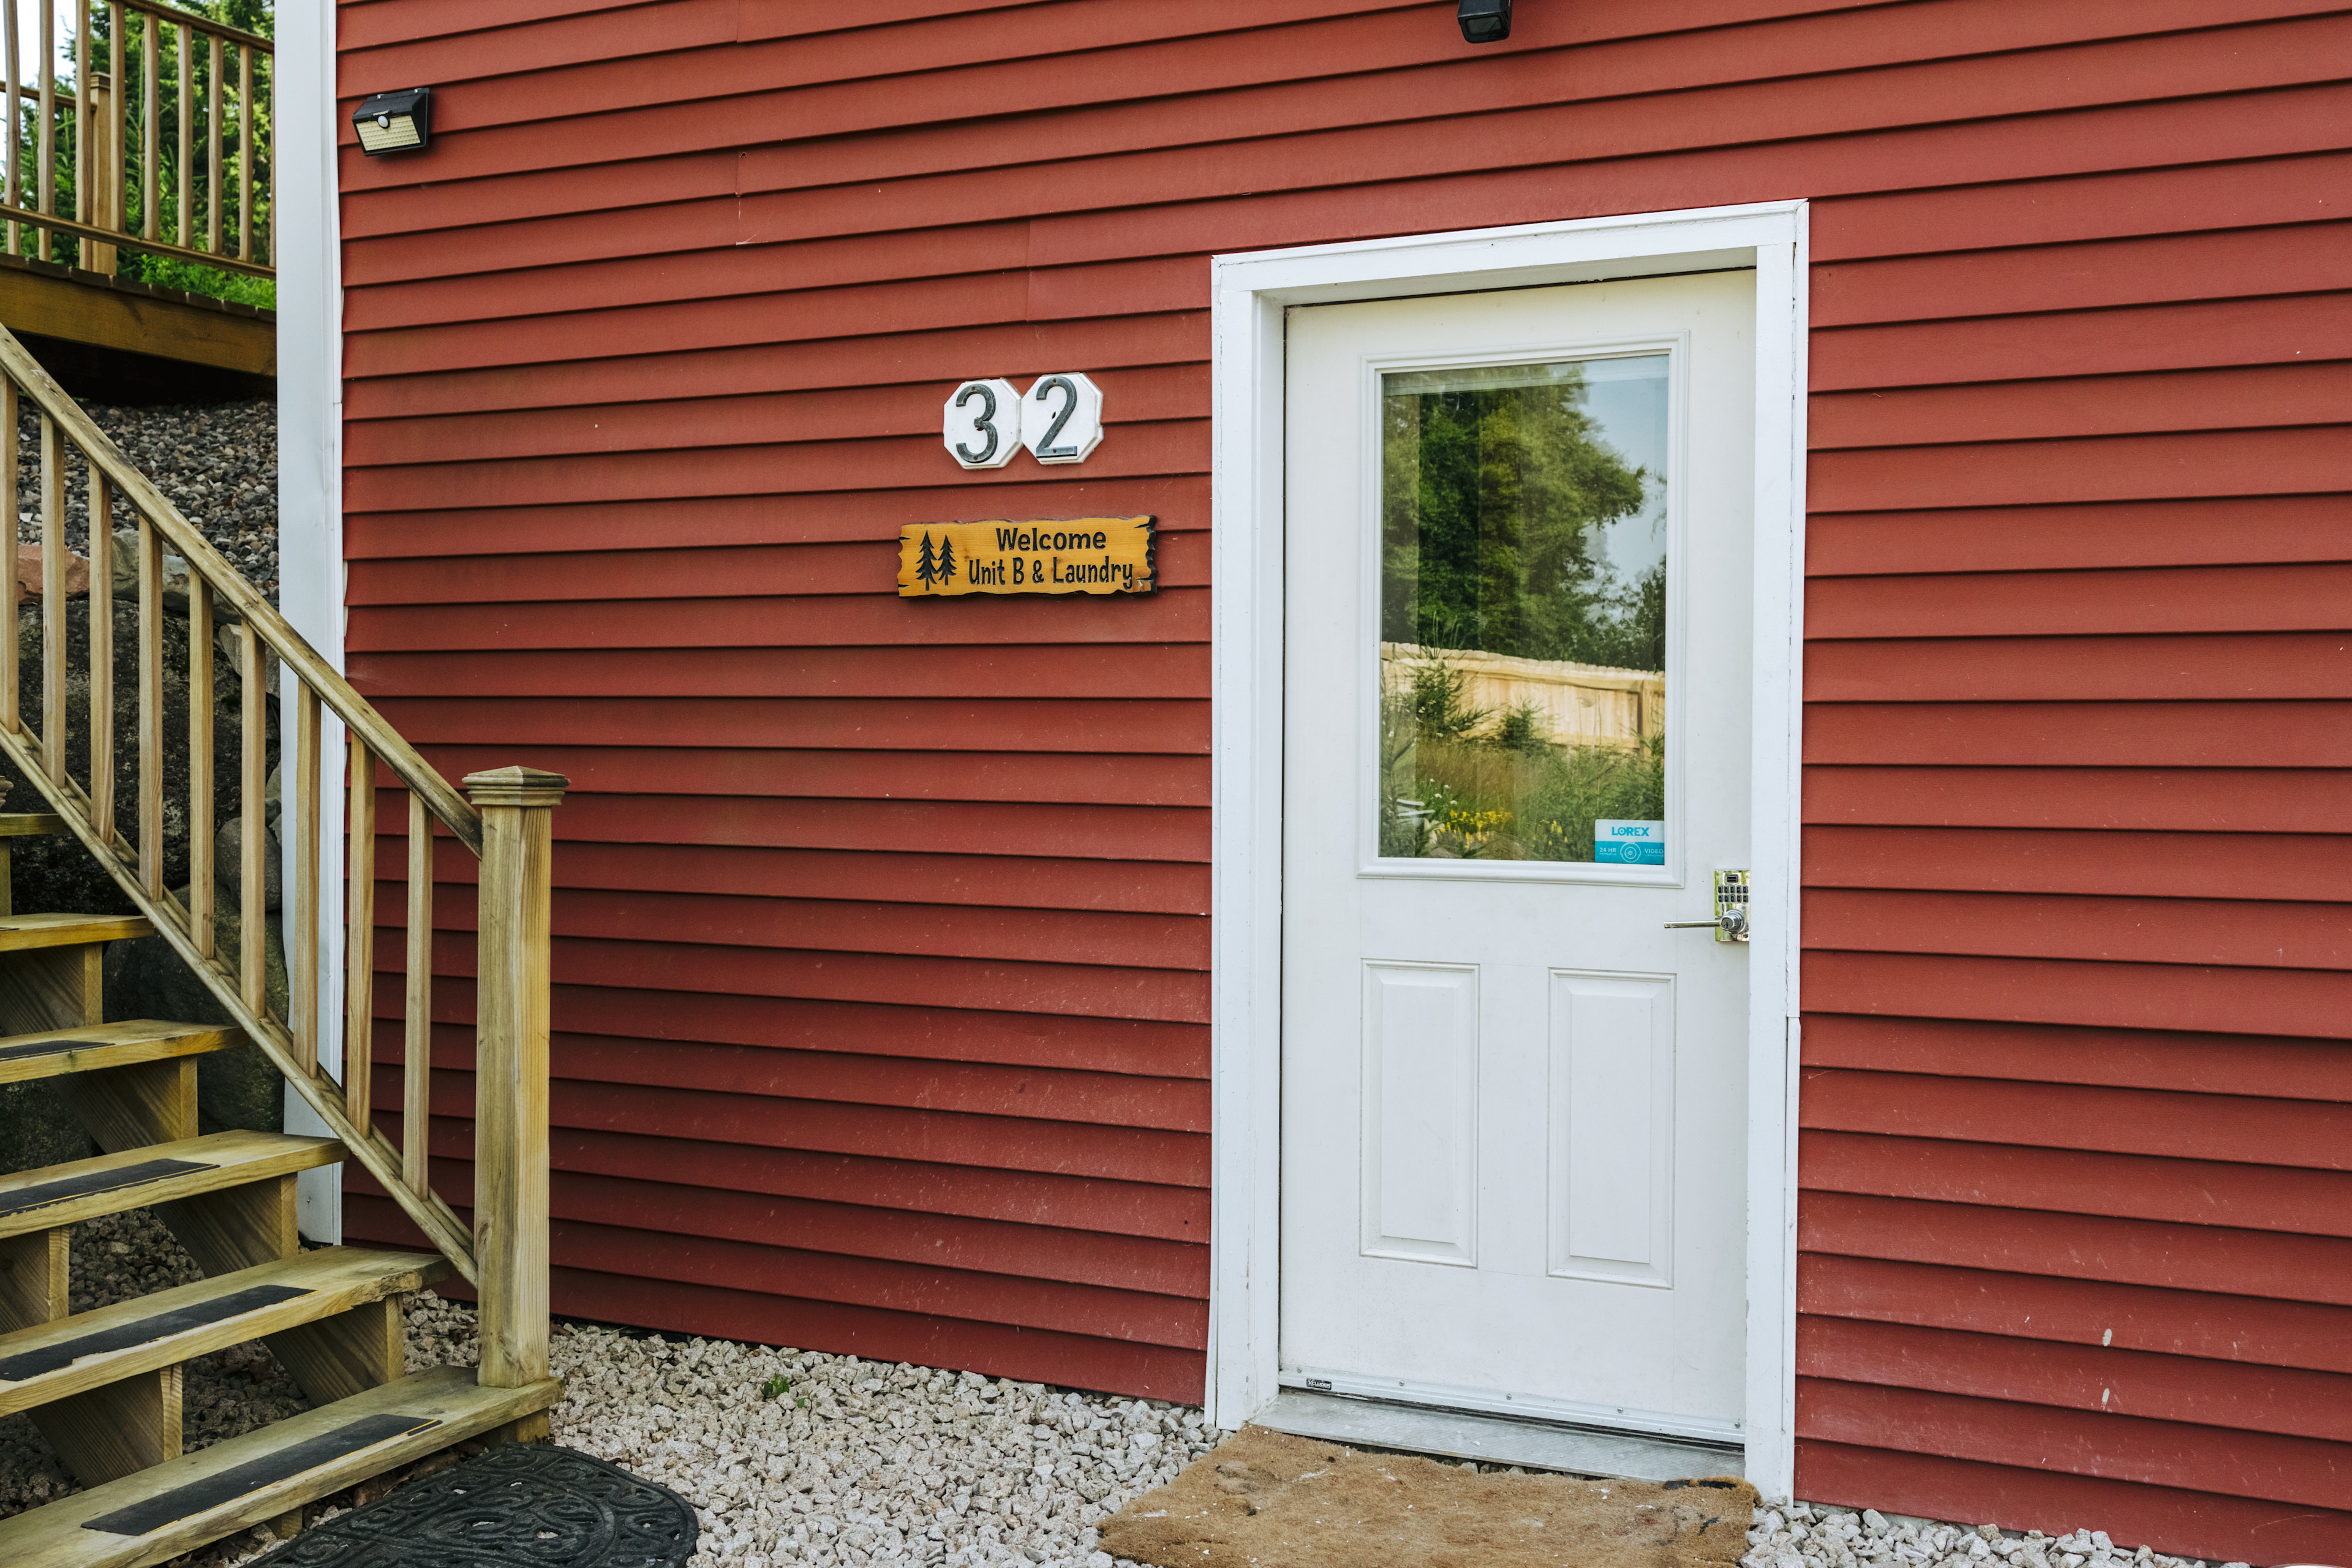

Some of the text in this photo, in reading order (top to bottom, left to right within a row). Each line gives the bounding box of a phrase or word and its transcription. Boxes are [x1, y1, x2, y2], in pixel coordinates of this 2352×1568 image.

[996, 528, 1106, 551] Welcome
[968, 556, 1133, 590] Unit B & Laundry
[1611, 826, 1649, 837] LOREX
